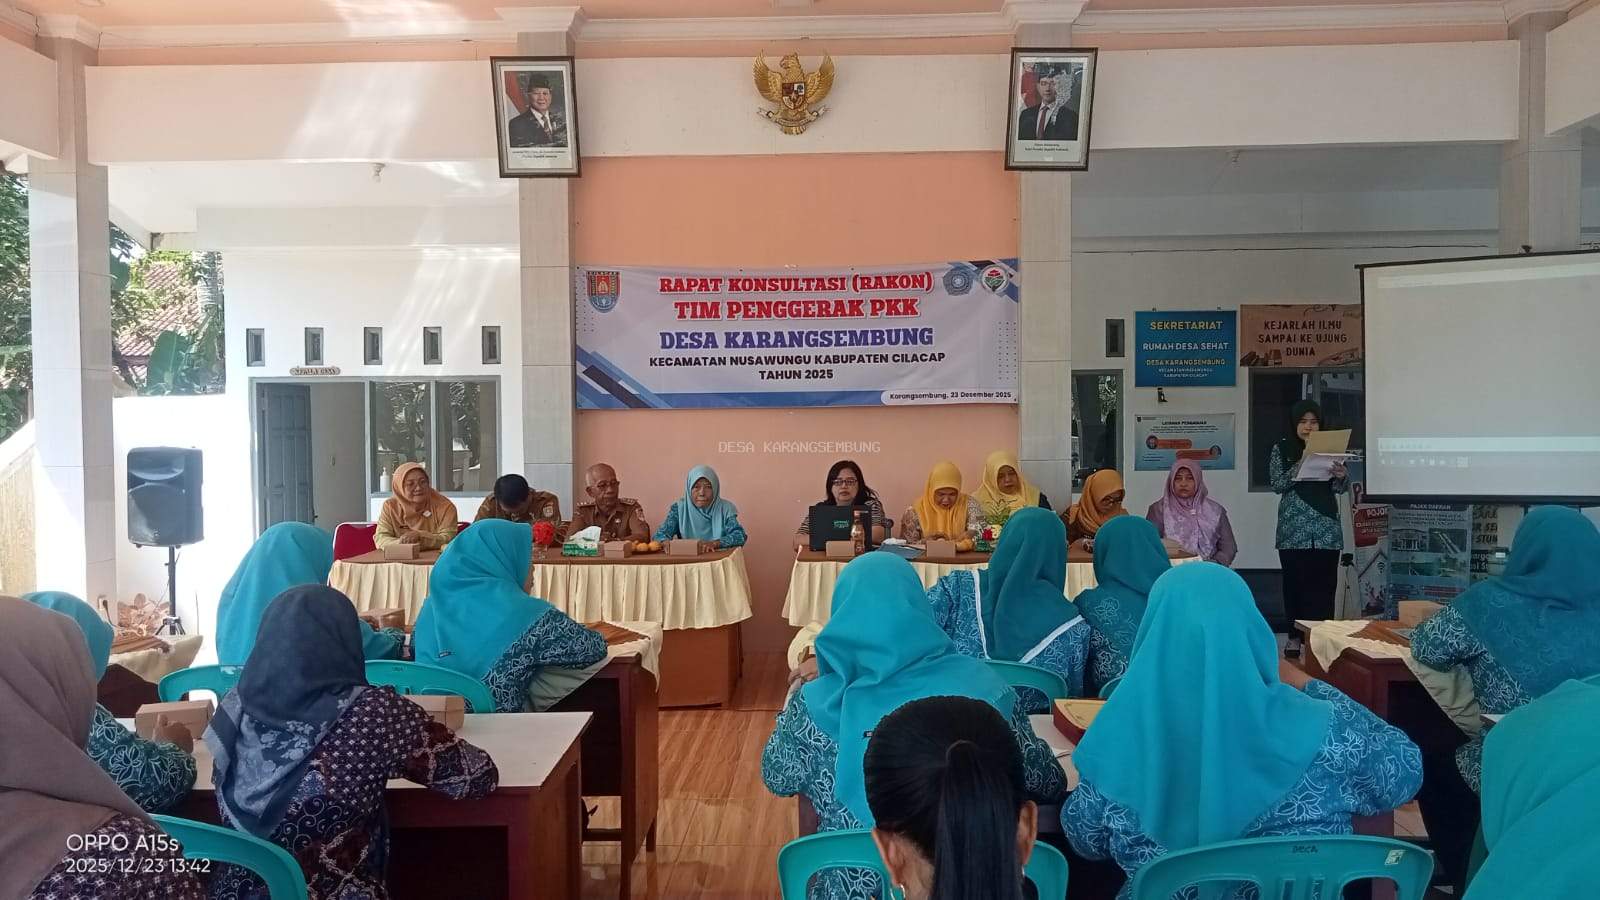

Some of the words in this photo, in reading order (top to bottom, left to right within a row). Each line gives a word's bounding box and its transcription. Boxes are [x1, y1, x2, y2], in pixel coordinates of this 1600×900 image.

[659, 277, 723, 293] RAPAT
[727, 276, 847, 293] KONSULTASI
[852, 271, 932, 293] (RAKON)
[674, 301, 721, 319] TIM
[726, 299, 865, 319] PENGGERAK
[869, 298, 919, 317] PKK
[1150, 321, 1223, 330] SEKRETARIAT
[1264, 320, 1315, 330] KEJARLAH
[1318, 320, 1342, 330] ILMU
[660, 331, 719, 349] DESA
[724, 327, 934, 349] KARANGSEMBUNG
[1258, 334, 1296, 343] SAMPAI
[1300, 334, 1312, 343] KE
[1316, 333, 1347, 343] UJUNG
[1142, 342, 1174, 351] RUMAH
[1175, 342, 1199, 350] DESA
[1200, 342, 1229, 350] SEHAT
[1286, 347, 1316, 356] DUNIA
[649, 356, 727, 367] KECAMATAN
[730, 355, 812, 366] NUSAWUNGU
[814, 353, 889, 365] KABUPATEN
[891, 352, 946, 364] CILACAP
[1165, 358, 1226, 366] KARANGSEMBUNG
[758, 370, 802, 380] TAHUN
[804, 369, 834, 380] 2025
[960, 390, 994, 398] Desember
